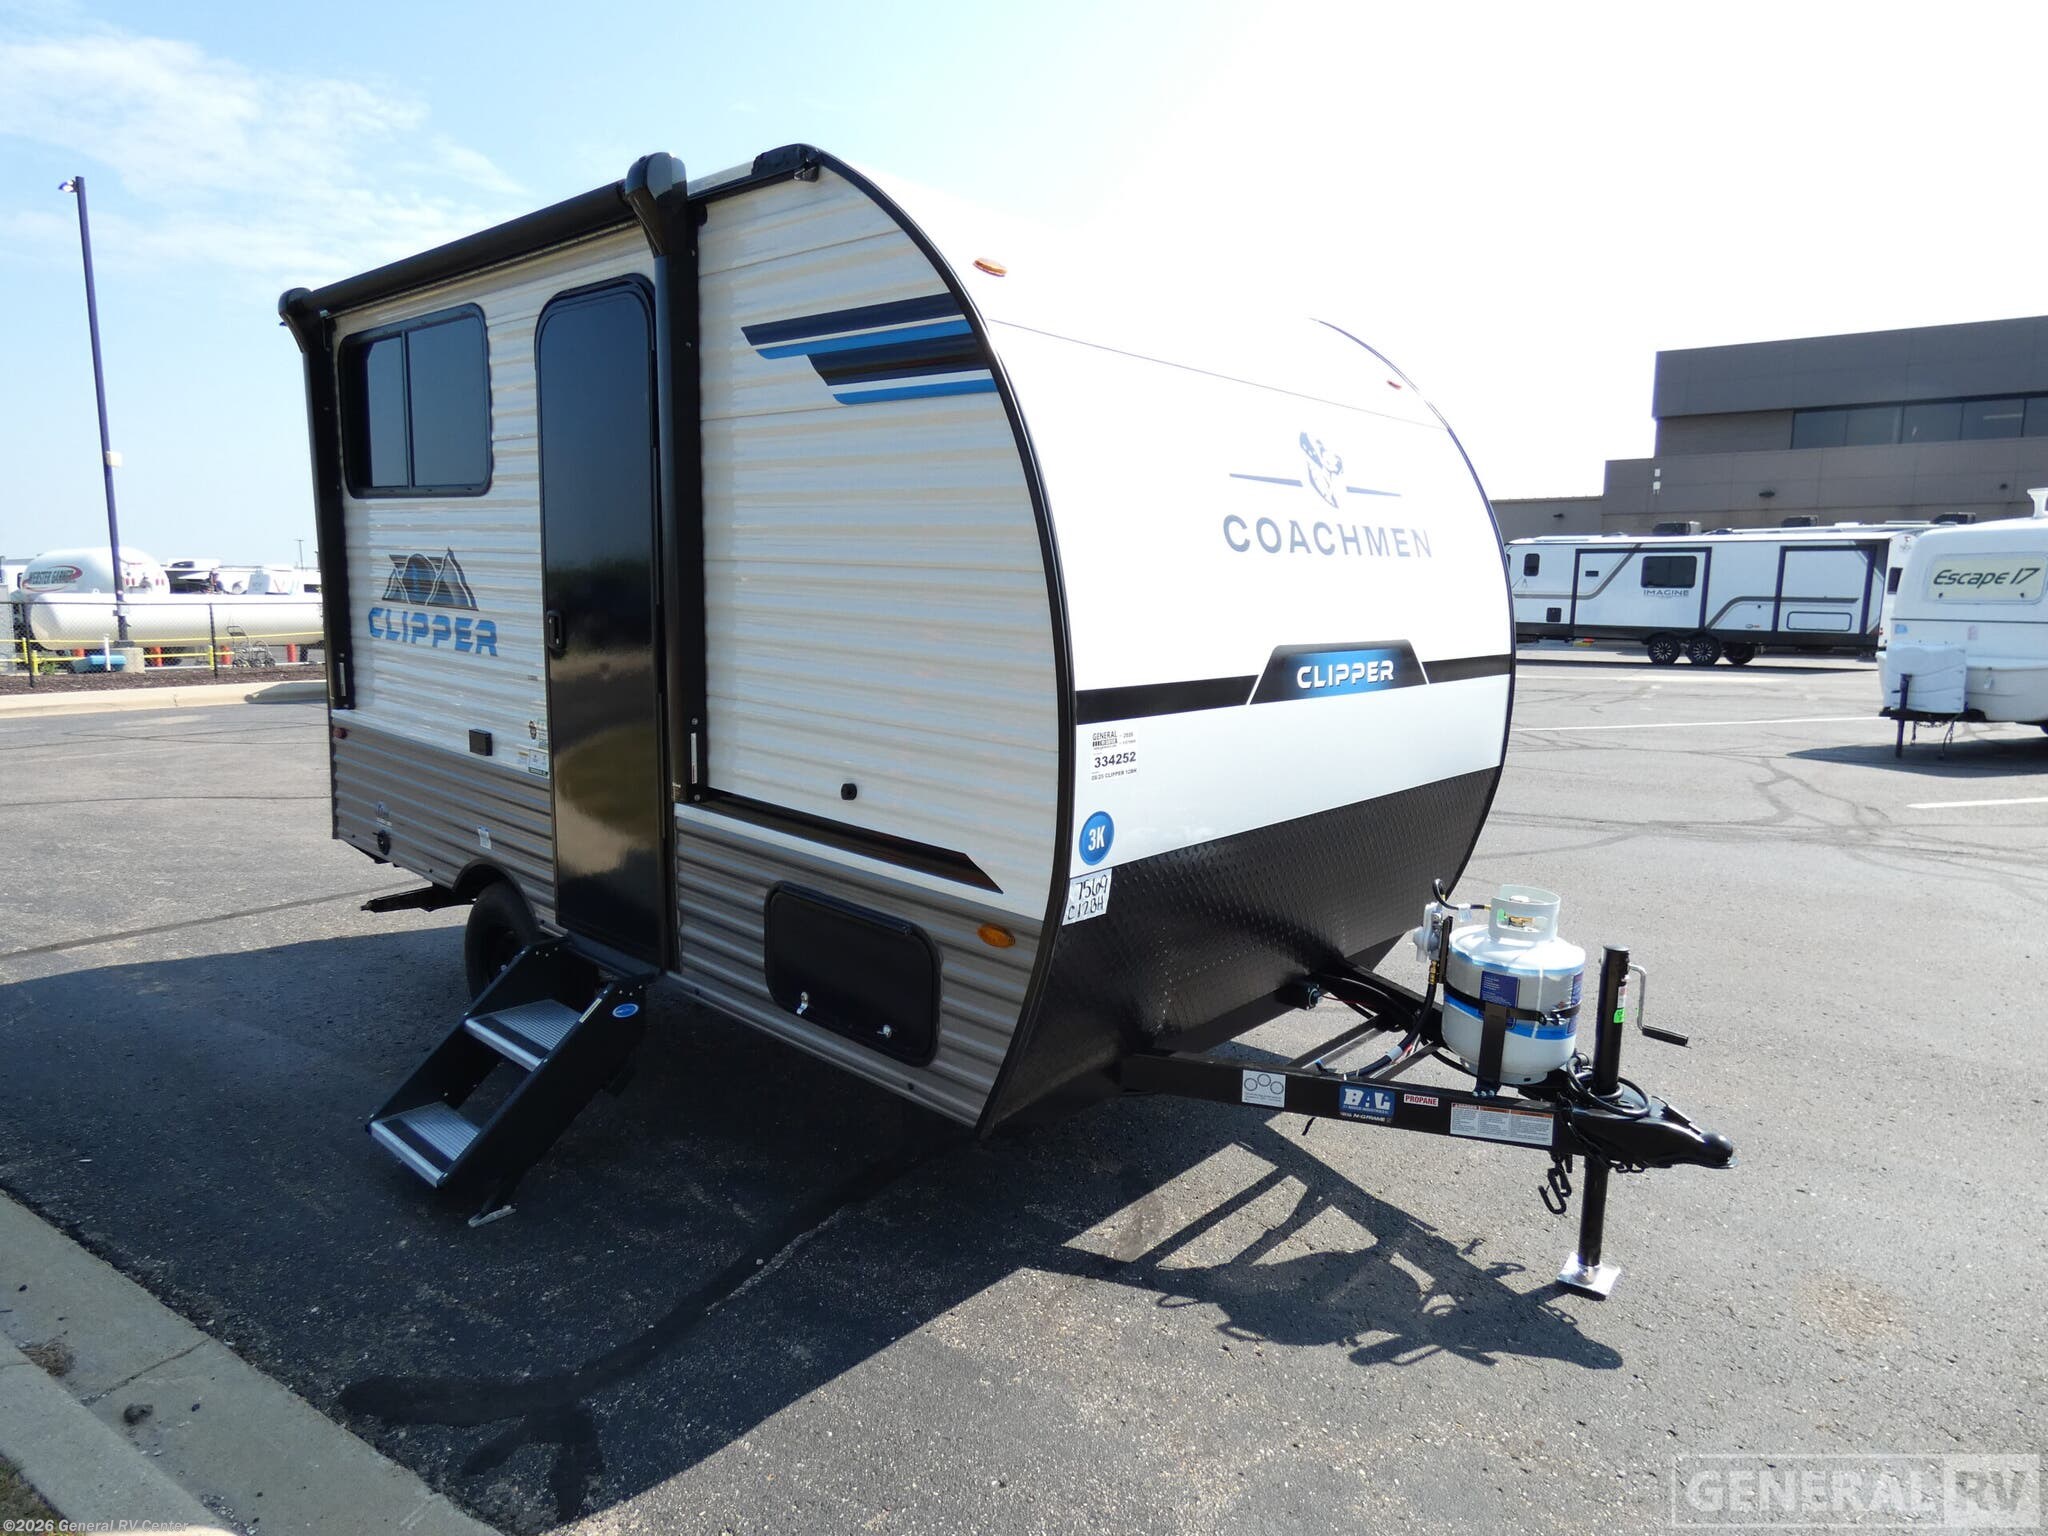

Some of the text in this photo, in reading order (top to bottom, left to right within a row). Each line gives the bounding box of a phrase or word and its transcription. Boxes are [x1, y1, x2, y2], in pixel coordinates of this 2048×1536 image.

[1223, 514, 1432, 558] COACHMEN
[1933, 567, 2041, 589] Escape 17
[1643, 589, 1690, 597] IMAGINE
[368, 606, 498, 657] CLIPPER
[1296, 659, 1394, 690] CLIPPER
[1094, 751, 1137, 769] 334252
[1088, 825, 1106, 851] 3K
[1075, 874, 1109, 900] 7569
[1343, 1088, 1391, 1111] BAL
[1404, 1094, 1438, 1106] PROPANE
